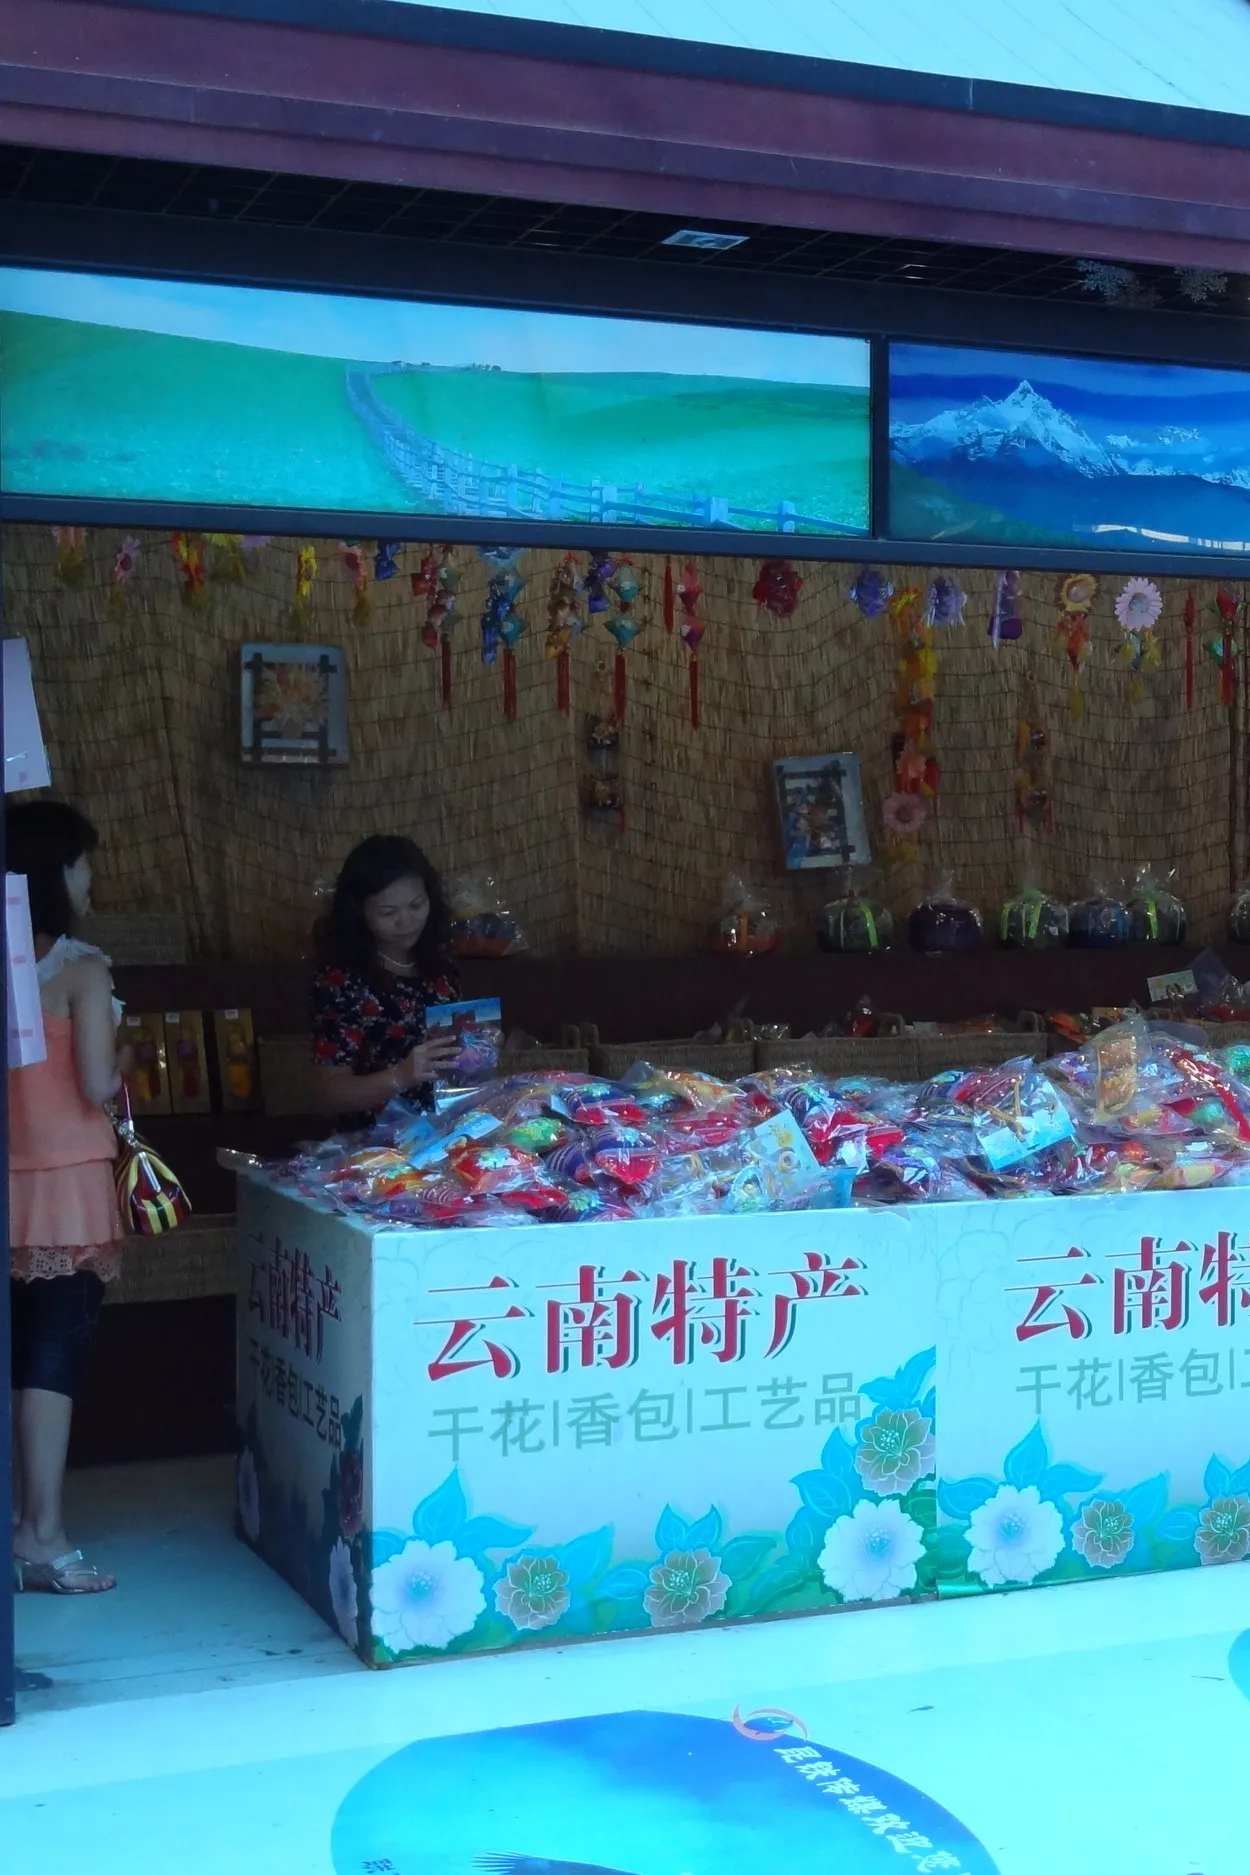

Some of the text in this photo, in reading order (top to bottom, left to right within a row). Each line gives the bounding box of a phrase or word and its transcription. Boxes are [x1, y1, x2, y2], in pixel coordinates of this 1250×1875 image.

[248, 1233, 342, 1365] 云南特产
[413, 1251, 869, 1381] 云南特产
[774, 1746, 971, 1875] 昆铁传媒欢迎您
